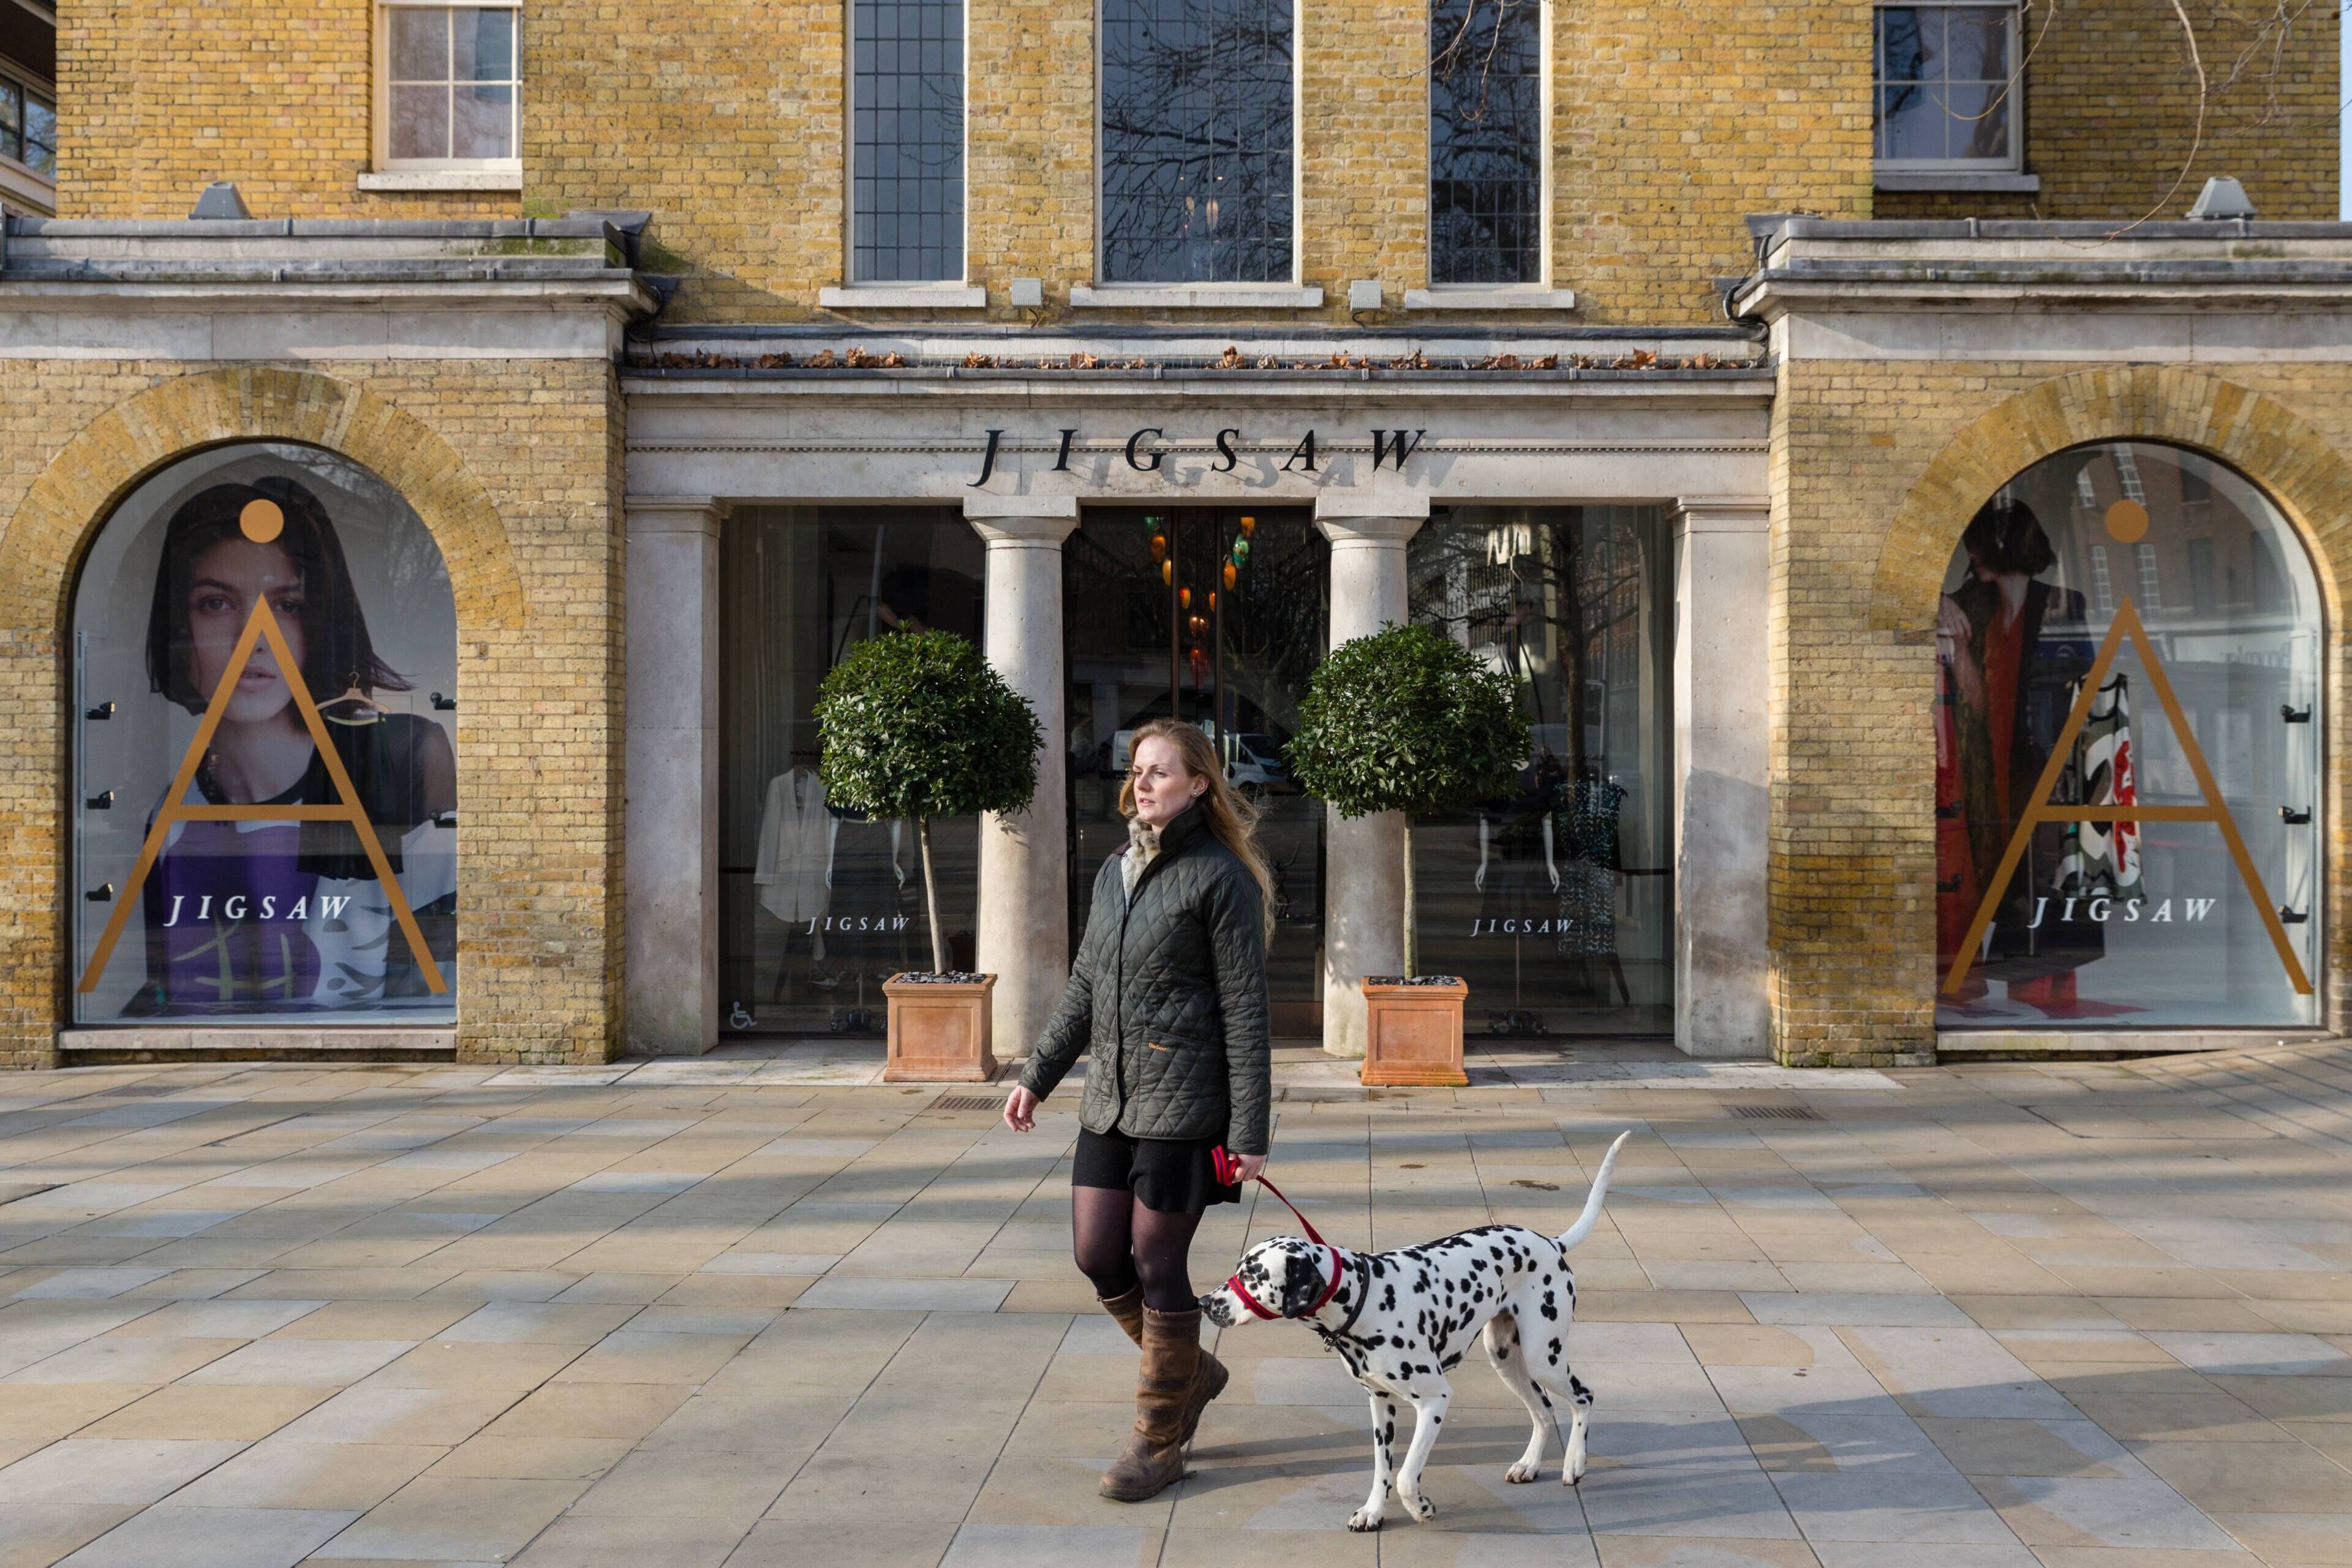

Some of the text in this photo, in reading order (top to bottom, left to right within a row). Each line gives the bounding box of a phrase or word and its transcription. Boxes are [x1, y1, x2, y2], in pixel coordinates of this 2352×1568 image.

[966, 428, 1427, 487] JIGSAW
[163, 895, 351, 927] JIGSAW
[2027, 897, 2216, 929] JIGSAW
[805, 917, 910, 935] JIGSAW
[1469, 919, 1573, 937] JIGSAW
[1148, 1042, 1167, 1051] Barbour
